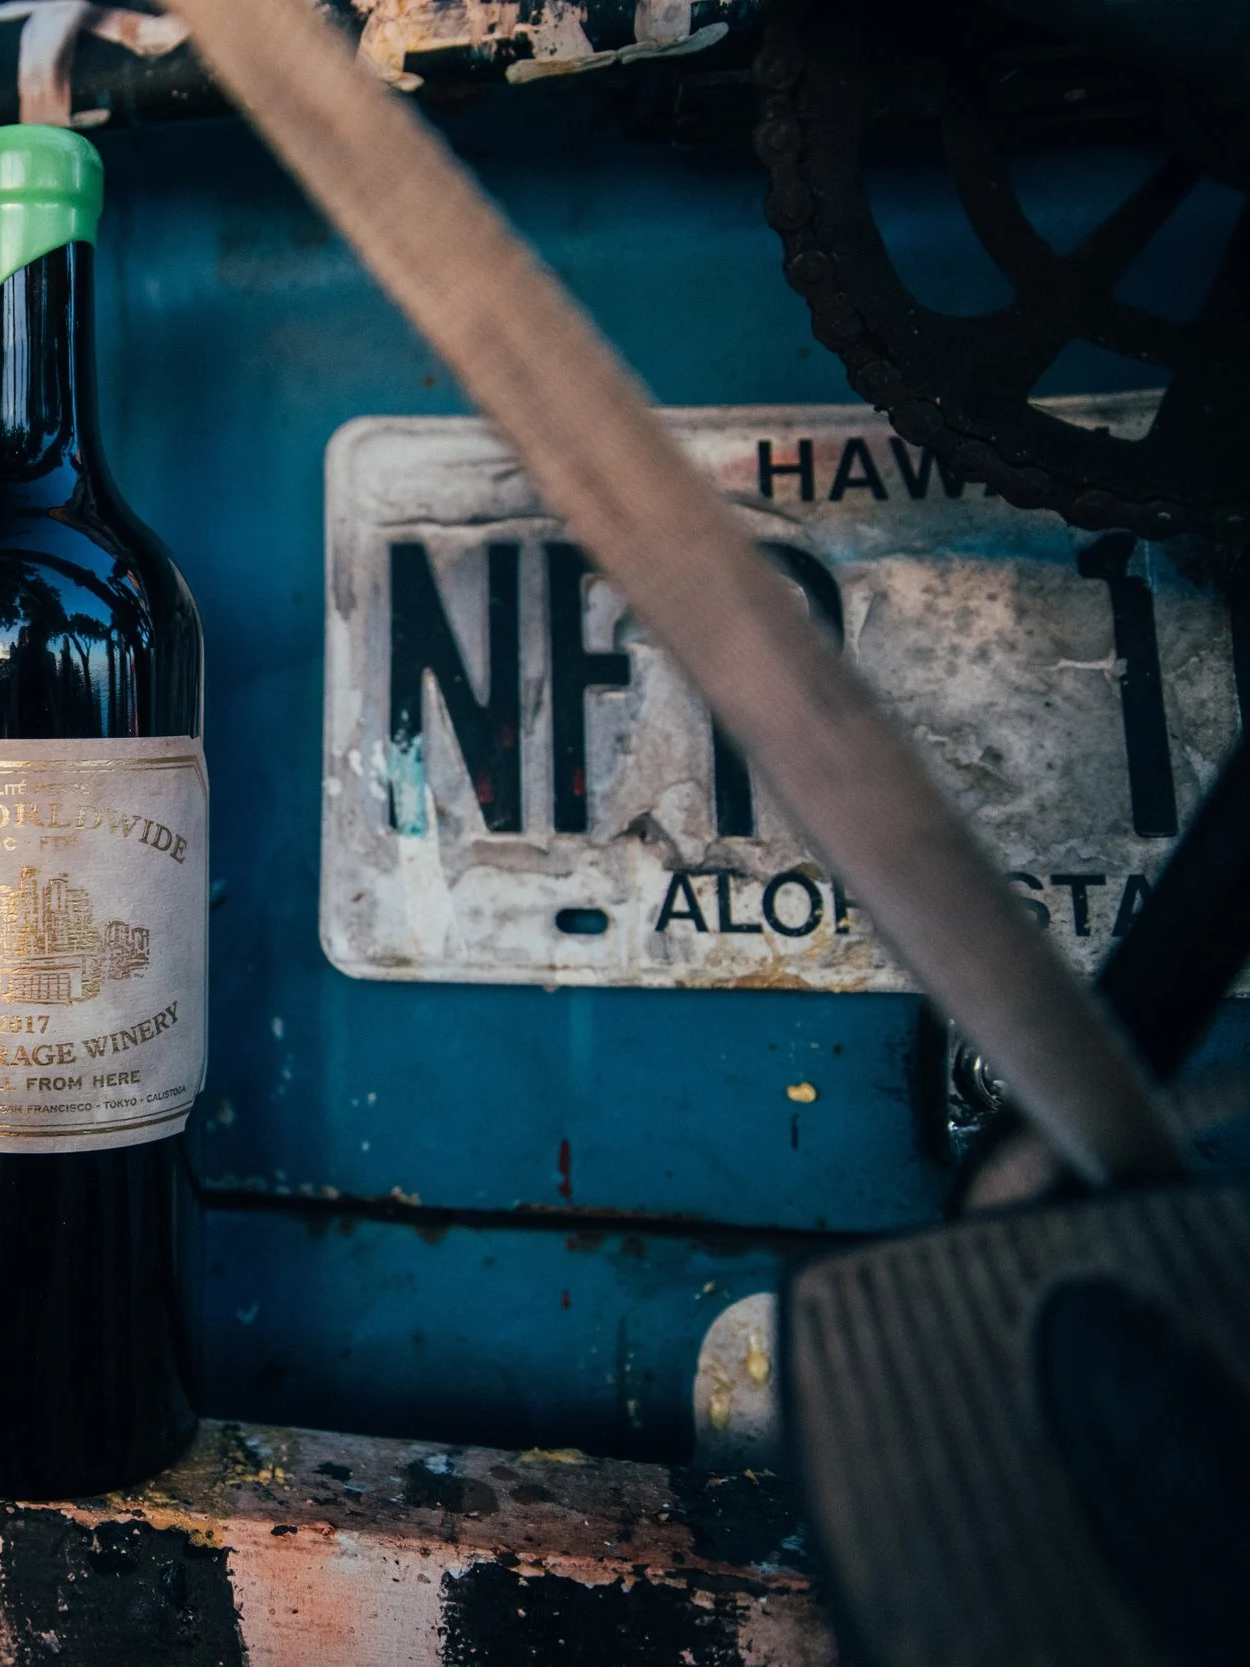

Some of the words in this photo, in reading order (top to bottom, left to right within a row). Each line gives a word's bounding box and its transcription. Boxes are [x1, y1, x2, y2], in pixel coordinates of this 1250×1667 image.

[81, 1000, 179, 1060] WINERY
[26, 1077, 82, 1092] FROM
[93, 1070, 141, 1089] HERE
[27, 1102, 93, 1114] FRANCISCO
[103, 1097, 137, 1109] TOKYO
